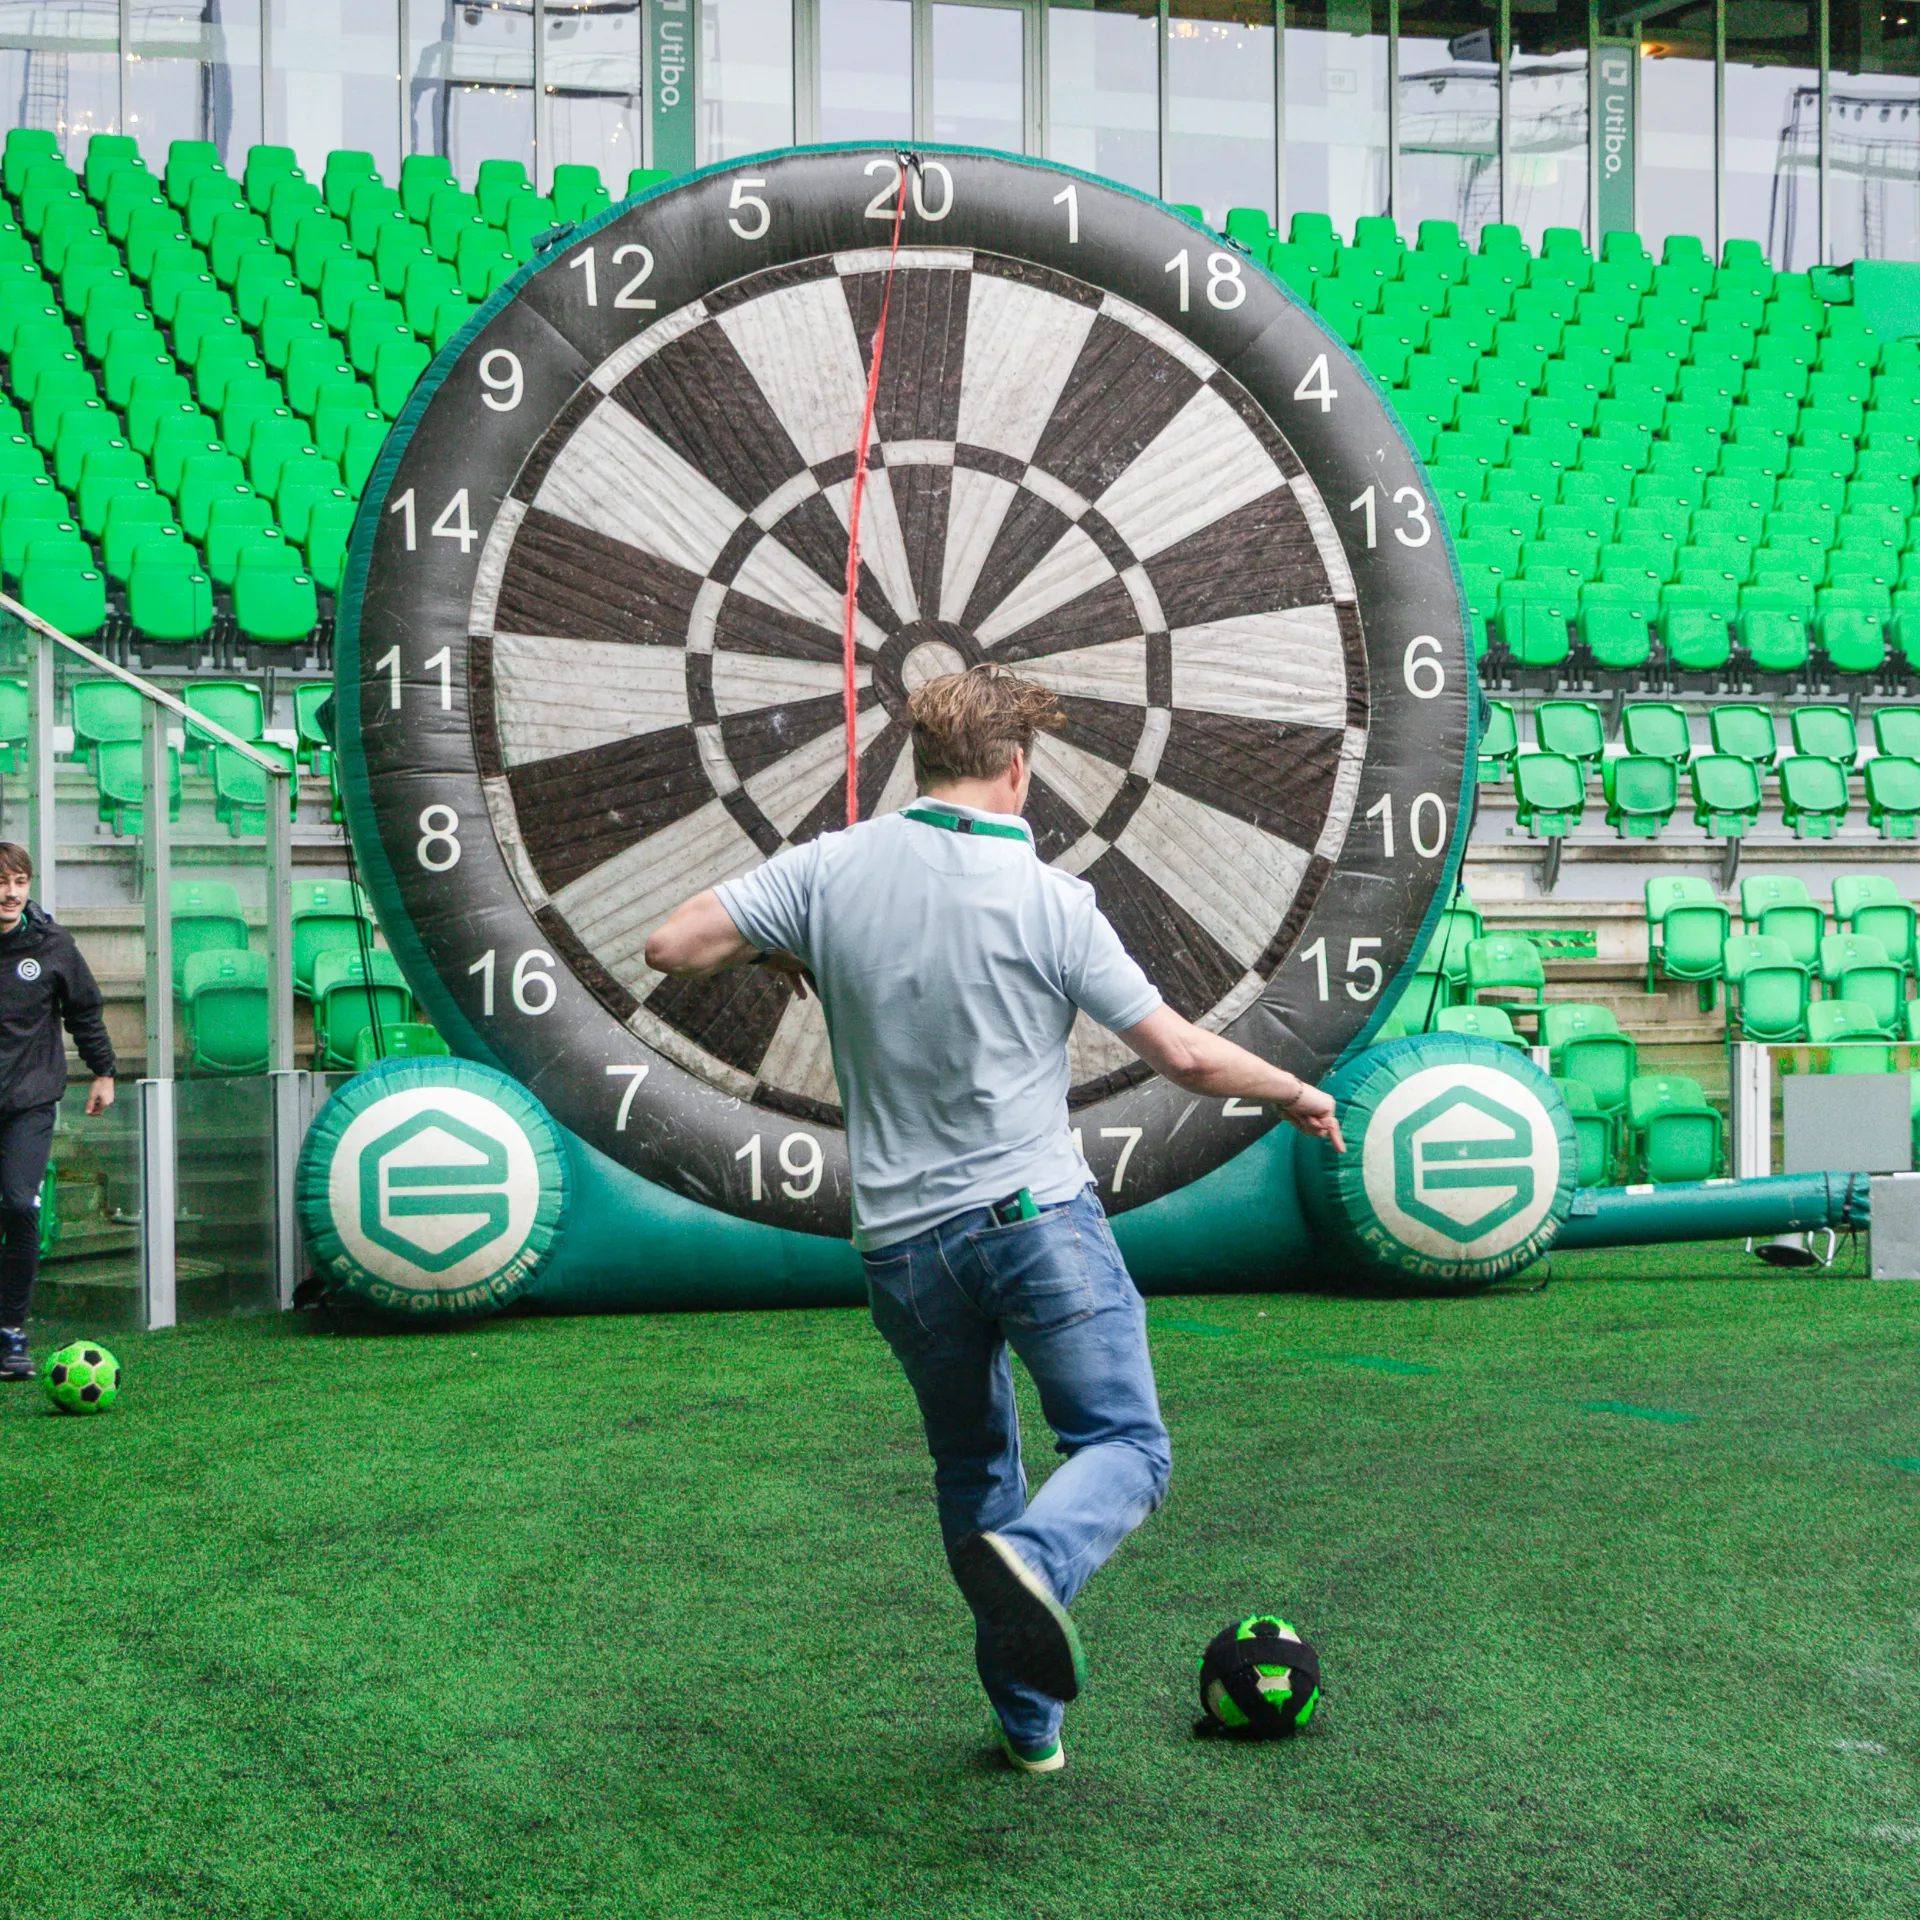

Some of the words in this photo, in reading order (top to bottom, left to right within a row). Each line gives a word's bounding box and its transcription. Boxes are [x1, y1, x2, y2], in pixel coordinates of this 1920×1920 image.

[660, 21, 686, 113] Utibo.
[1605, 95, 1627, 179] Utibo.
[728, 178, 772, 240] 5
[864, 159, 954, 222] 20
[1053, 185, 1080, 244] 1
[569, 243, 657, 310] 12
[1164, 249, 1247, 312] 18
[479, 348, 524, 412] 9
[1293, 353, 1339, 413] 4
[391, 488, 479, 553] 14
[1350, 486, 1432, 549] 13
[375, 645, 452, 711] 11
[1403, 635, 1446, 700] 6
[417, 804, 462, 872] 8
[1366, 791, 1448, 859] 10
[469, 948, 558, 1016] 16
[1300, 936, 1384, 1002] 15
[605, 1064, 650, 1132] 7
[735, 1132, 825, 1201] 19
